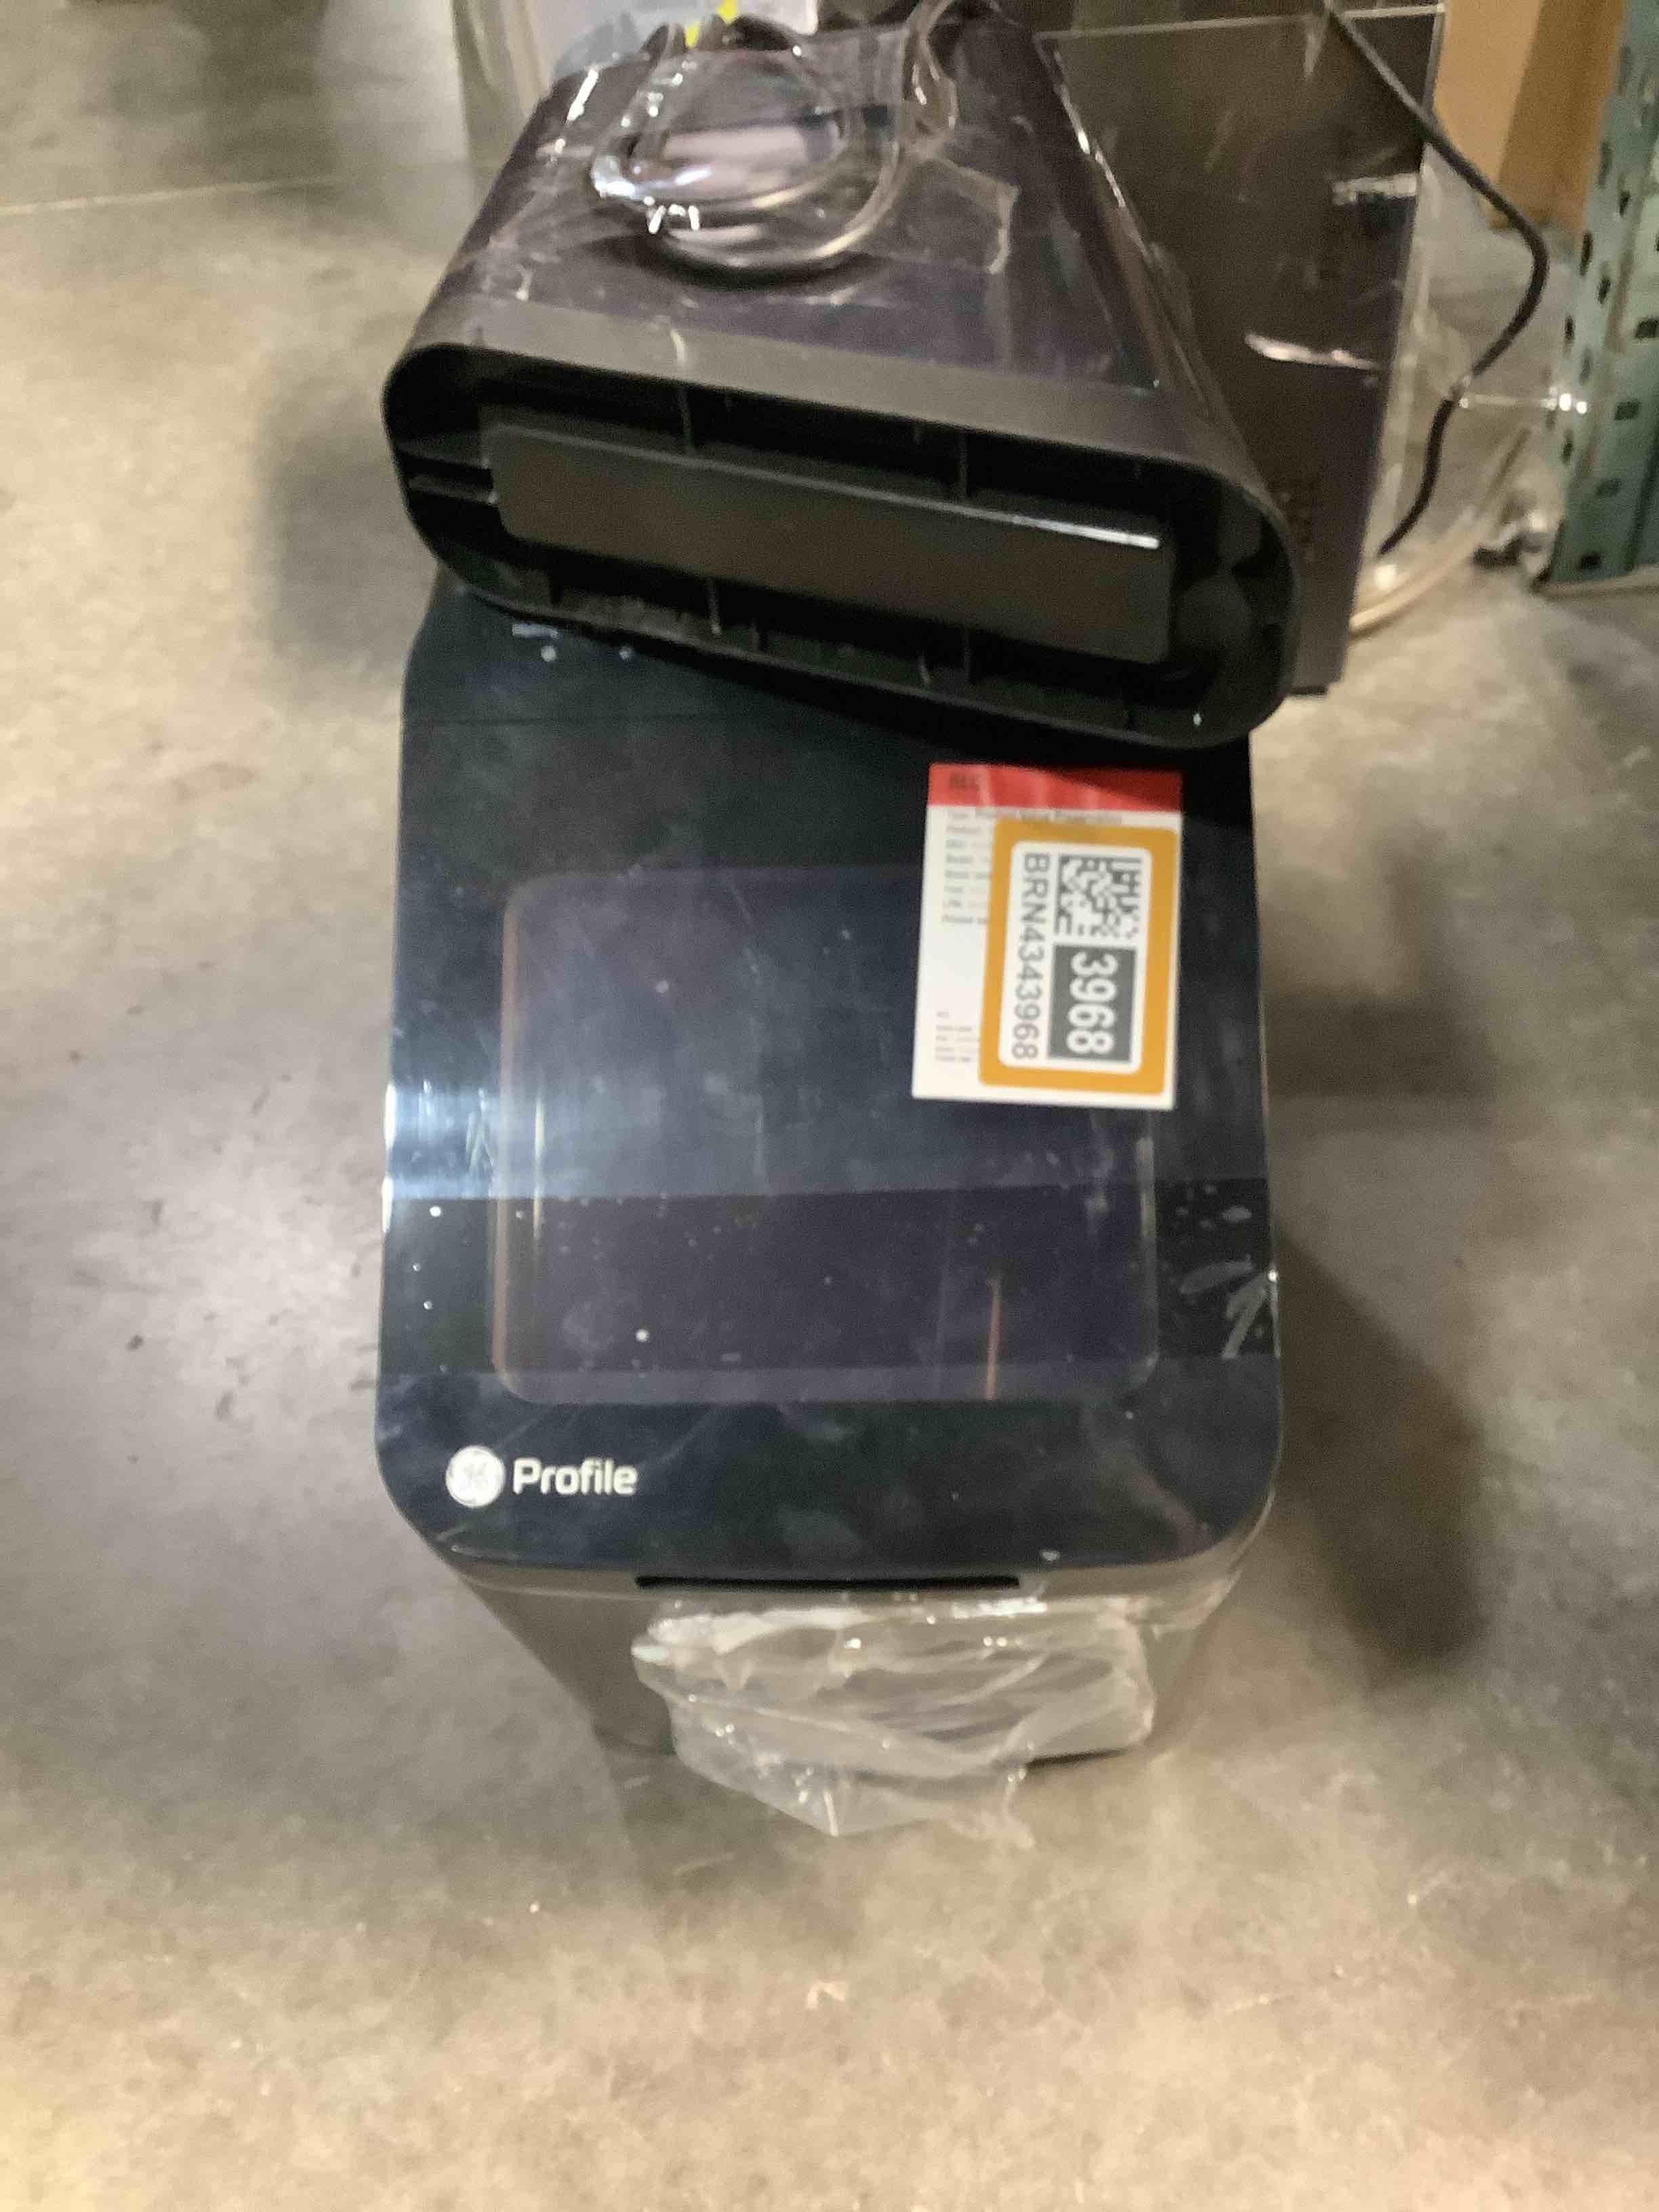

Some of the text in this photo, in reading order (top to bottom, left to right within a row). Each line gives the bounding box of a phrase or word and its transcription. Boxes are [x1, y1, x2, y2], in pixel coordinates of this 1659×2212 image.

[1012, 853, 1050, 1059] BRN4343968
[1066, 951, 1118, 1055] 3968
[513, 1457, 638, 1495] Profile
